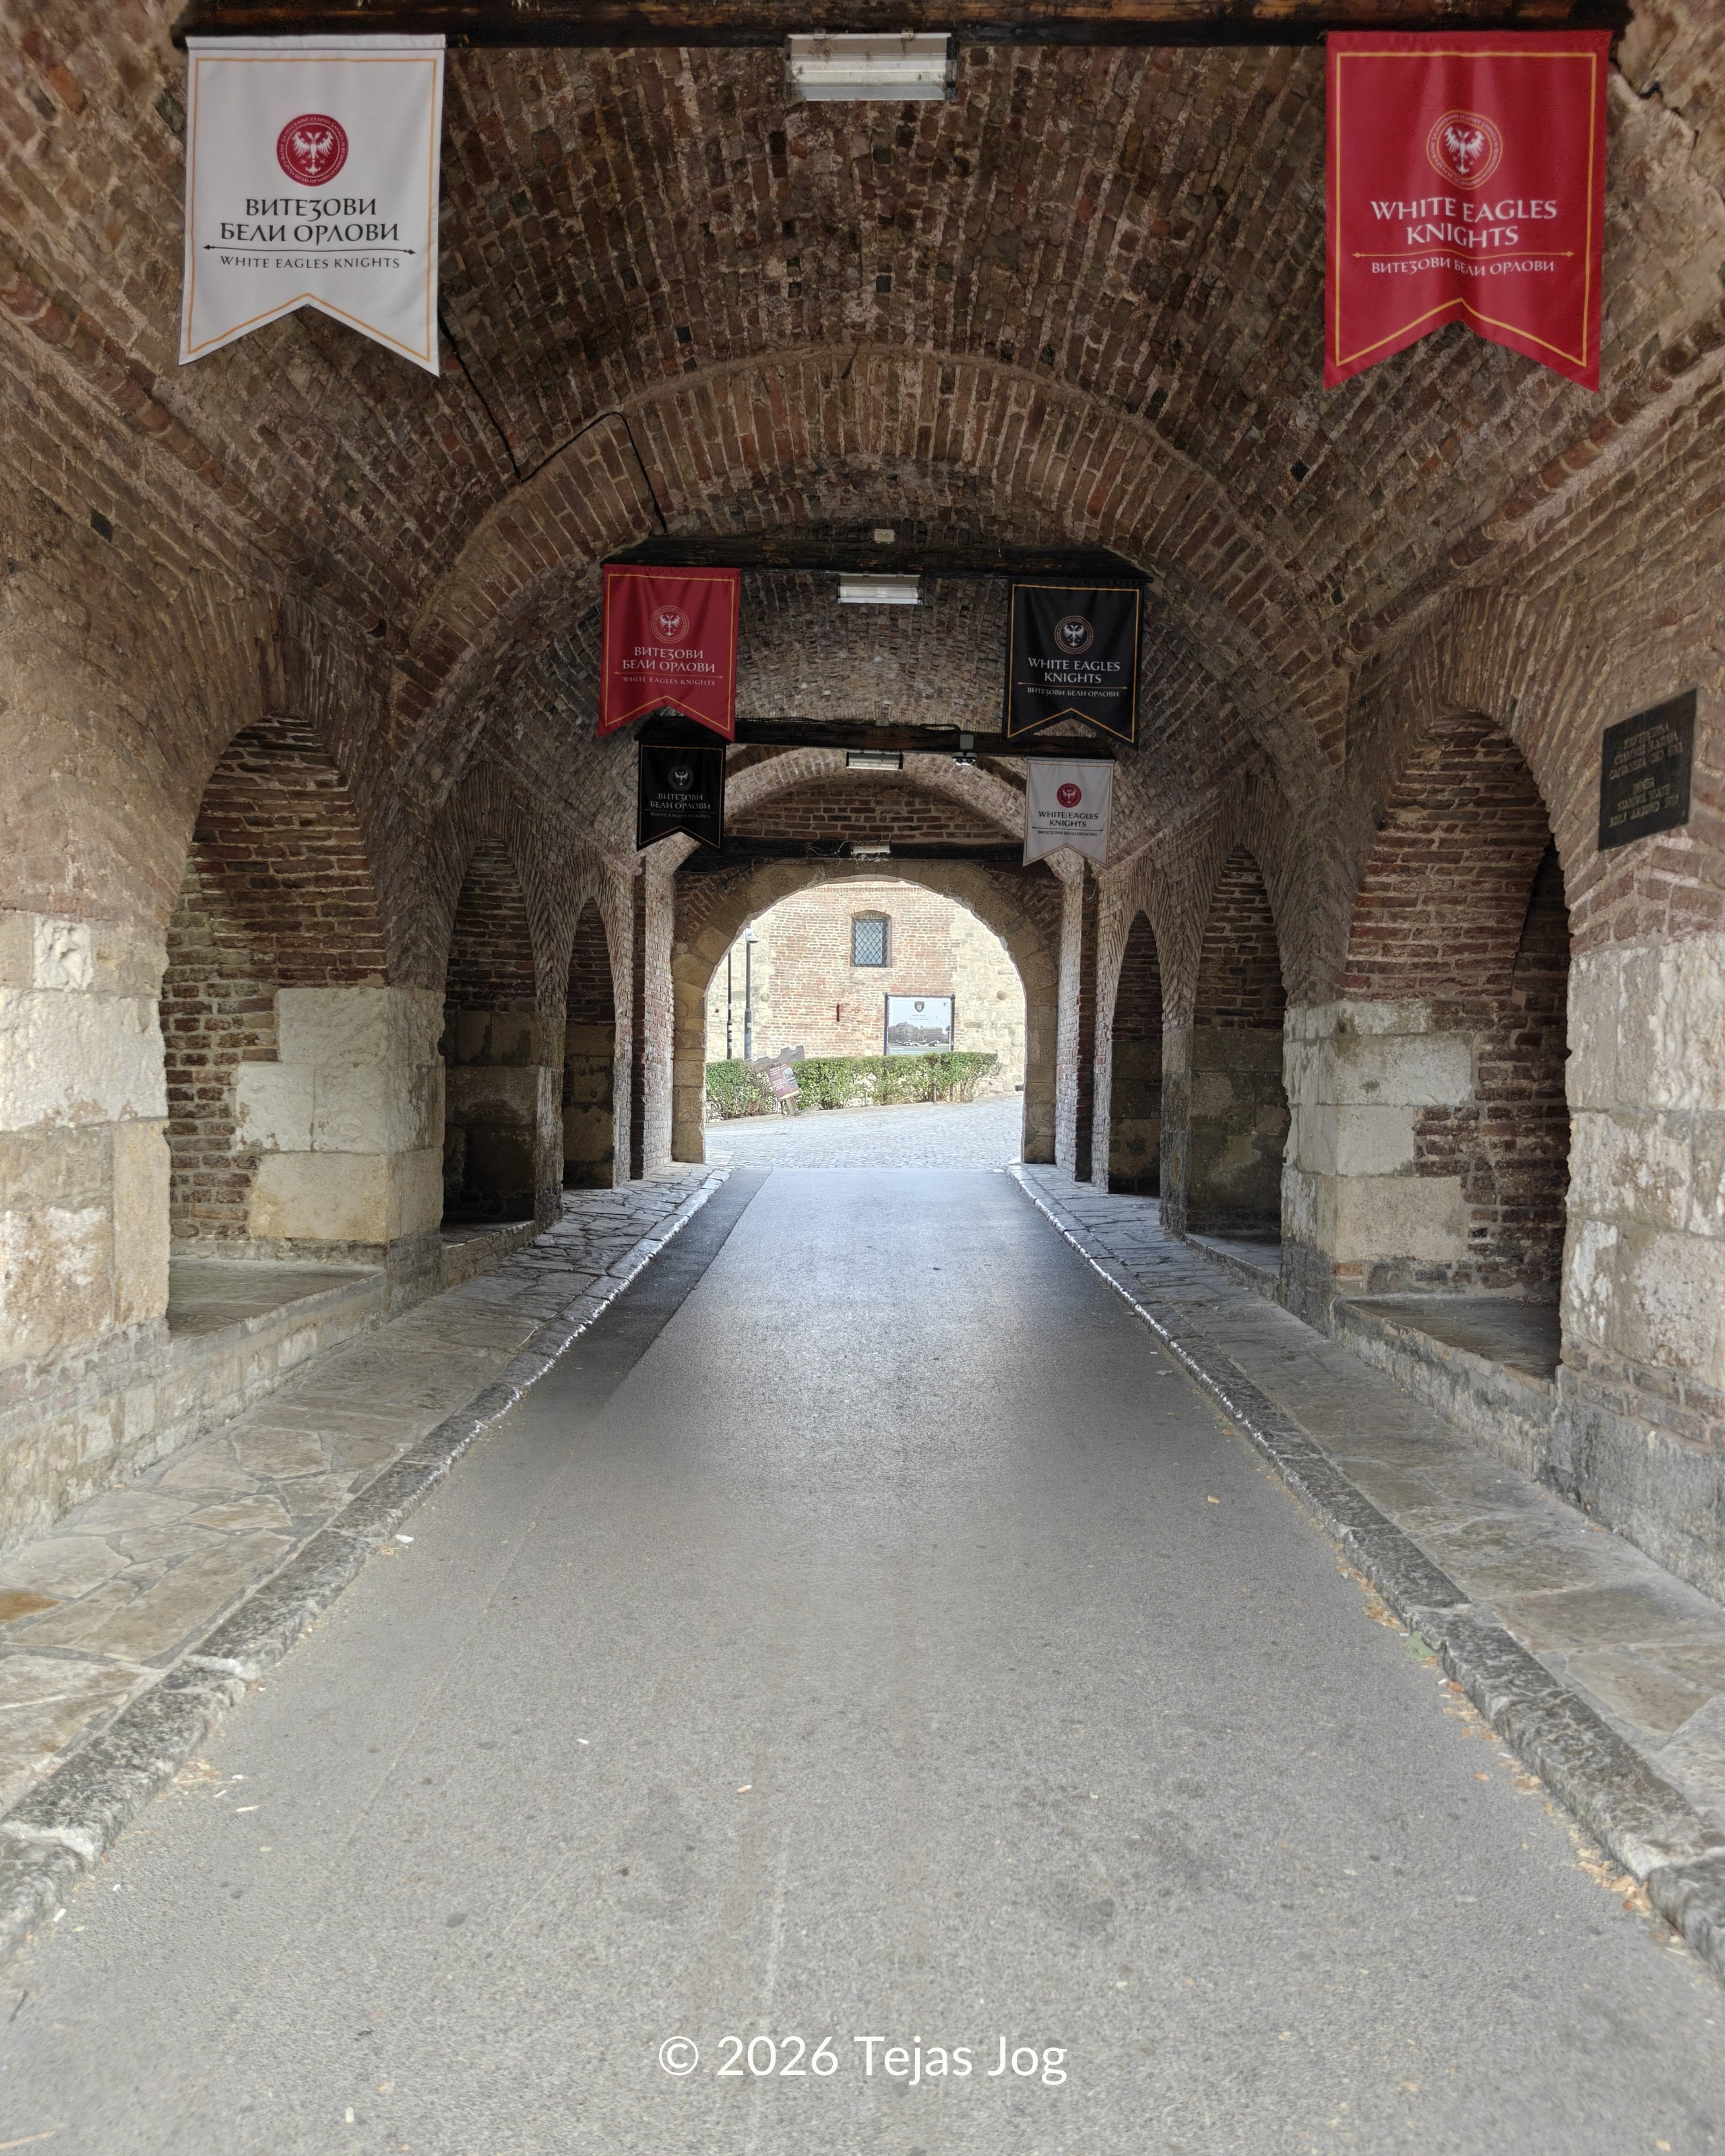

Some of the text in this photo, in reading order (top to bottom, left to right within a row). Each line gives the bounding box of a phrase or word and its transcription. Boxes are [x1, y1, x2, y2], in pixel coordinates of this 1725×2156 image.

[245, 198, 377, 222] ВИТЕЗОВИ
[1371, 197, 1557, 223] WHITE EAGLES
[220, 222, 400, 247] БЕЛИ ОРЛОВИ
[1406, 222, 1519, 248] KNIGHTS
[220, 255, 400, 270] WHITE EAGLES KNIGHTS
[1371, 257, 1555, 276] ВИТЕЗОВИ БЕЛИ ОРЛОВИ
[634, 646, 703, 661] ВИТЕЗОВИ
[623, 660, 716, 673] БЕЛИ ОРЛОВИ
[1028, 658, 1121, 672] WHITE EAGLES
[1044, 672, 1102, 683] KNIGHTS
[1027, 687, 1065, 696] ВИТЕЗОВИ
[658, 793, 703, 802] ВИТЕЗОВИ
[650, 800, 711, 811] БЕЛИ ОРЛОВИ
